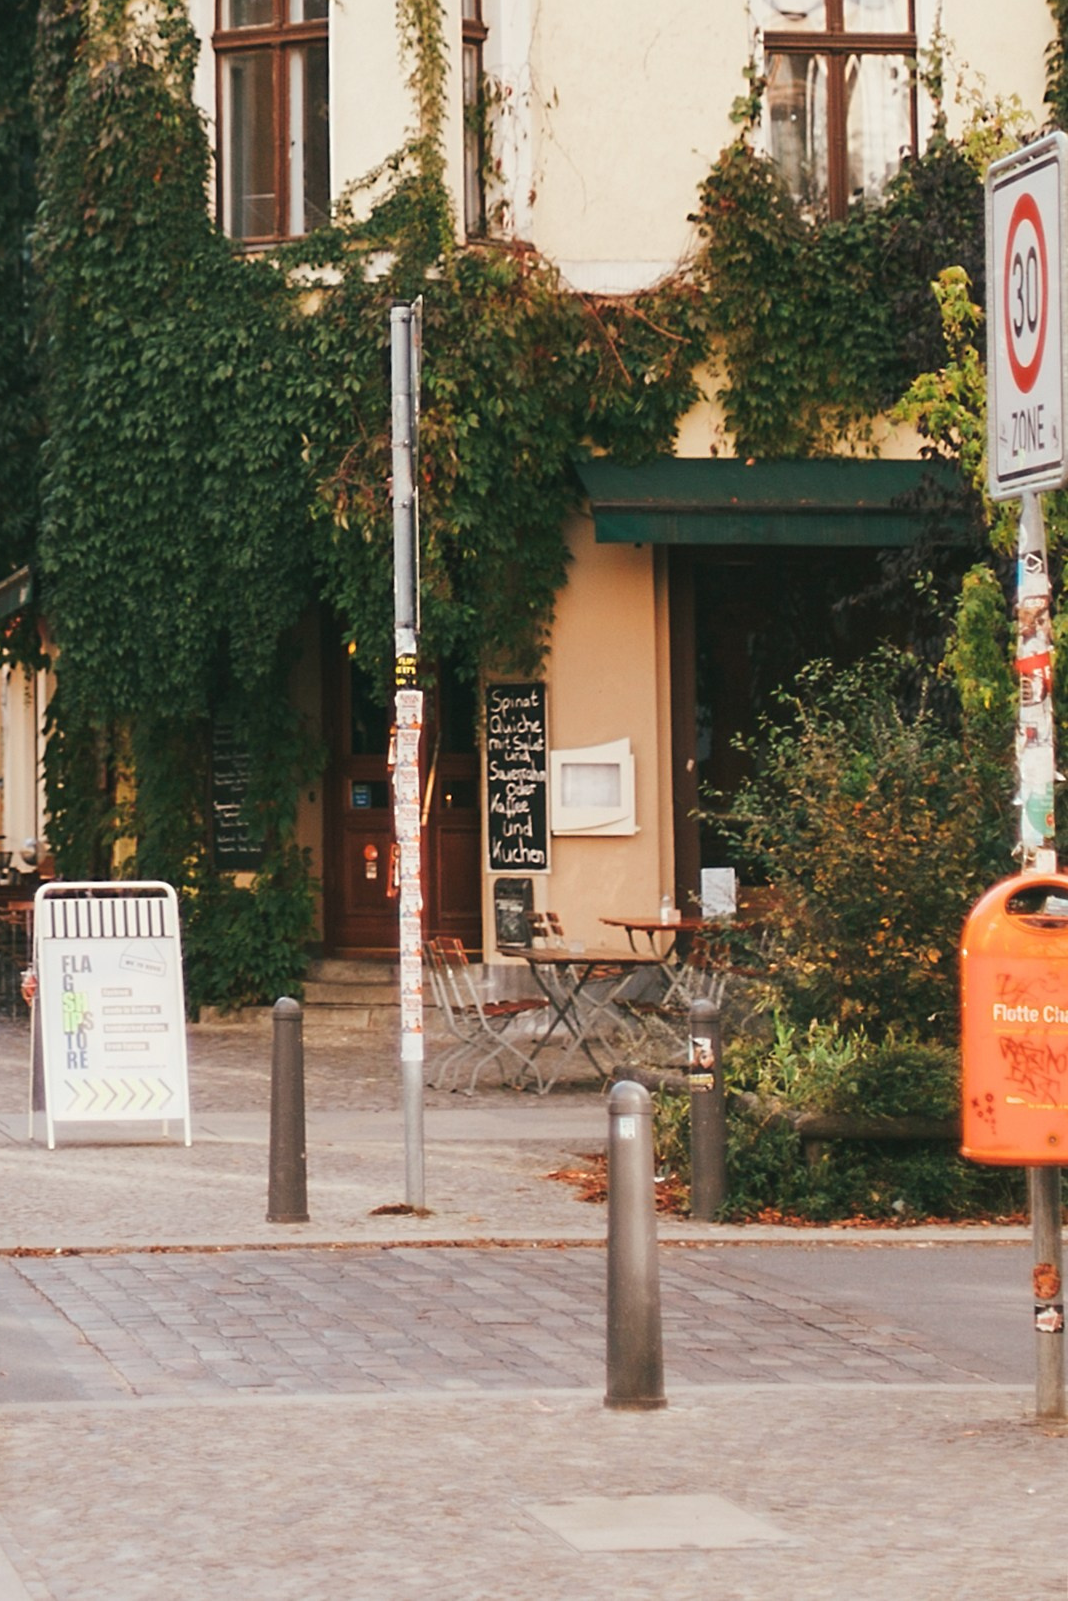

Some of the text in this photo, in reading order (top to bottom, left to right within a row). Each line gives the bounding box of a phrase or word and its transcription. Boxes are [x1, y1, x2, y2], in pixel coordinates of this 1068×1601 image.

[1012, 246, 1039, 338] 30
[1012, 404, 1045, 456] ZONE
[490, 690, 539, 717] Spinat
[490, 713, 542, 734] Quiche
[488, 735, 511, 750] mit
[504, 751, 531, 763] und
[491, 793, 530, 818] Kaffee
[503, 814, 533, 838] und
[492, 837, 545, 865] Kuchen
[61, 954, 92, 973] FLA
[63, 974, 74, 992] G
[993, 1003, 1039, 1022] Flotte
[66, 1050, 89, 1069] RE
